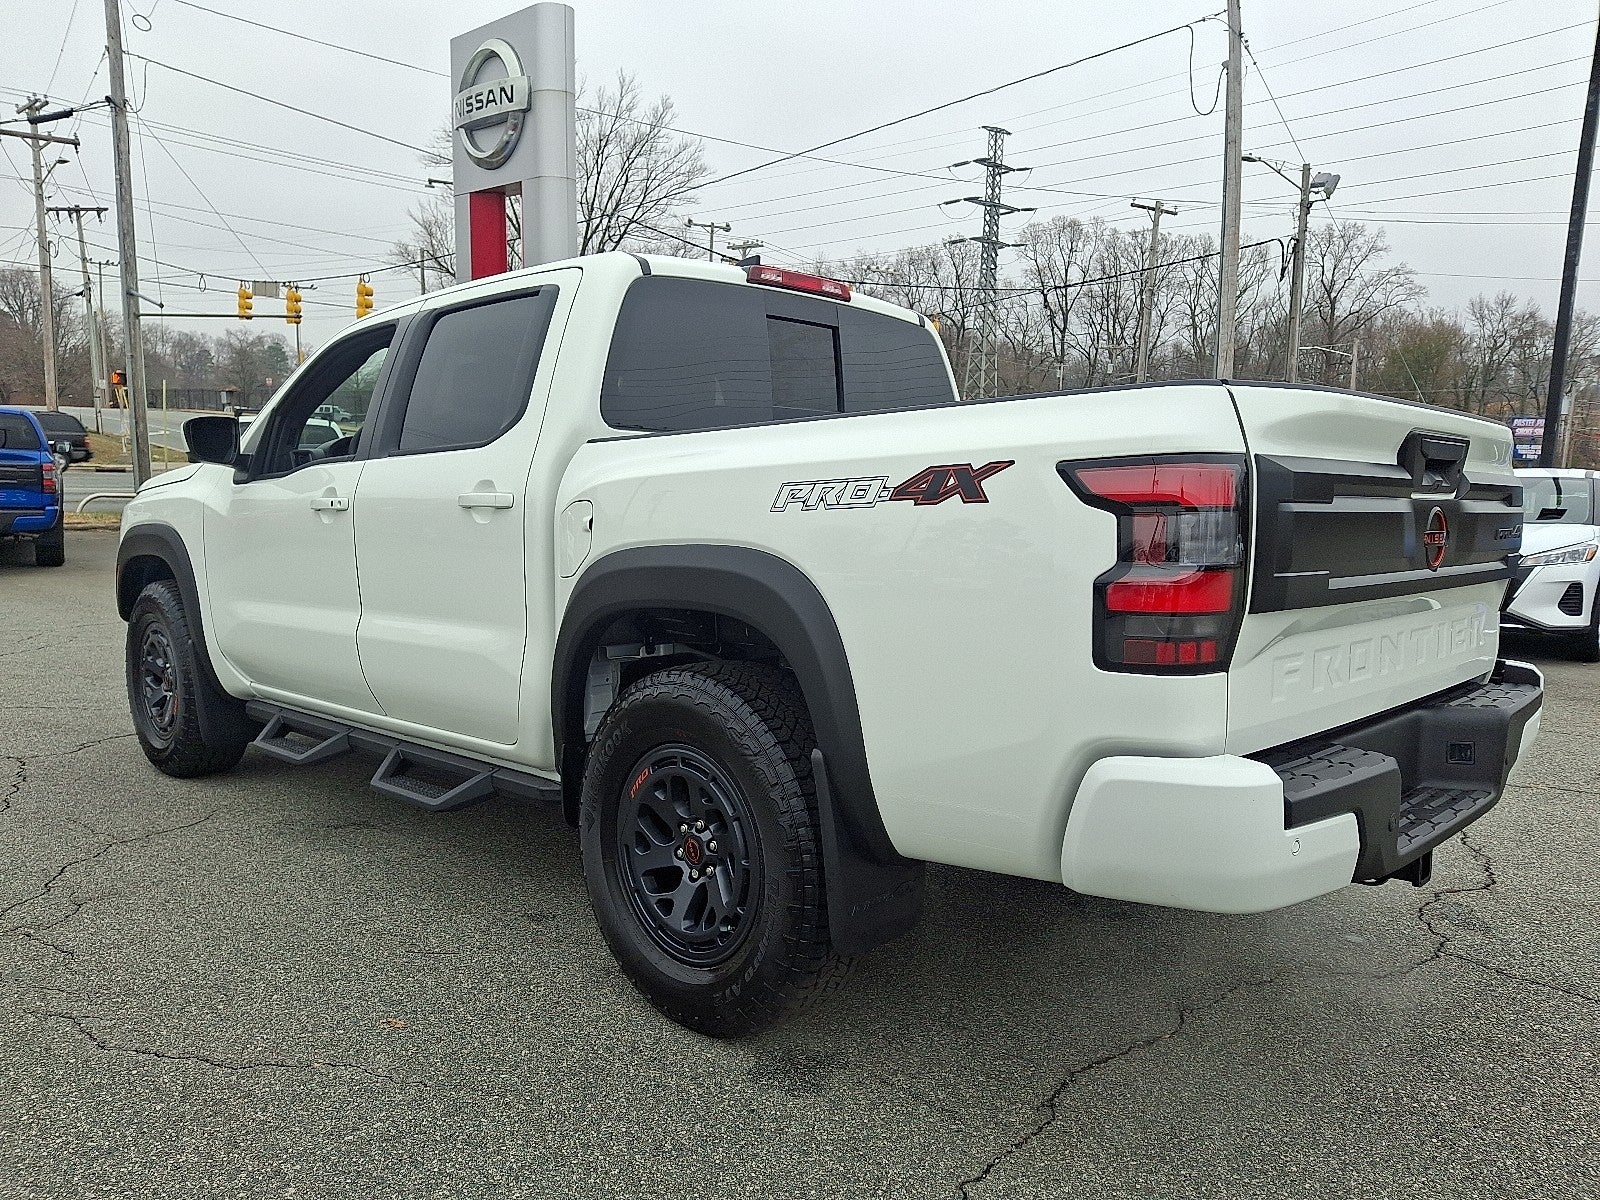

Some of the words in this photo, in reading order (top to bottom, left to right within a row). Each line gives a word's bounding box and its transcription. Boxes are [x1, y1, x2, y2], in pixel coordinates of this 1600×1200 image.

[455, 84, 514, 118] NISSAN
[1270, 609, 1488, 703] FRONTIER
[629, 766, 651, 800] PRO
